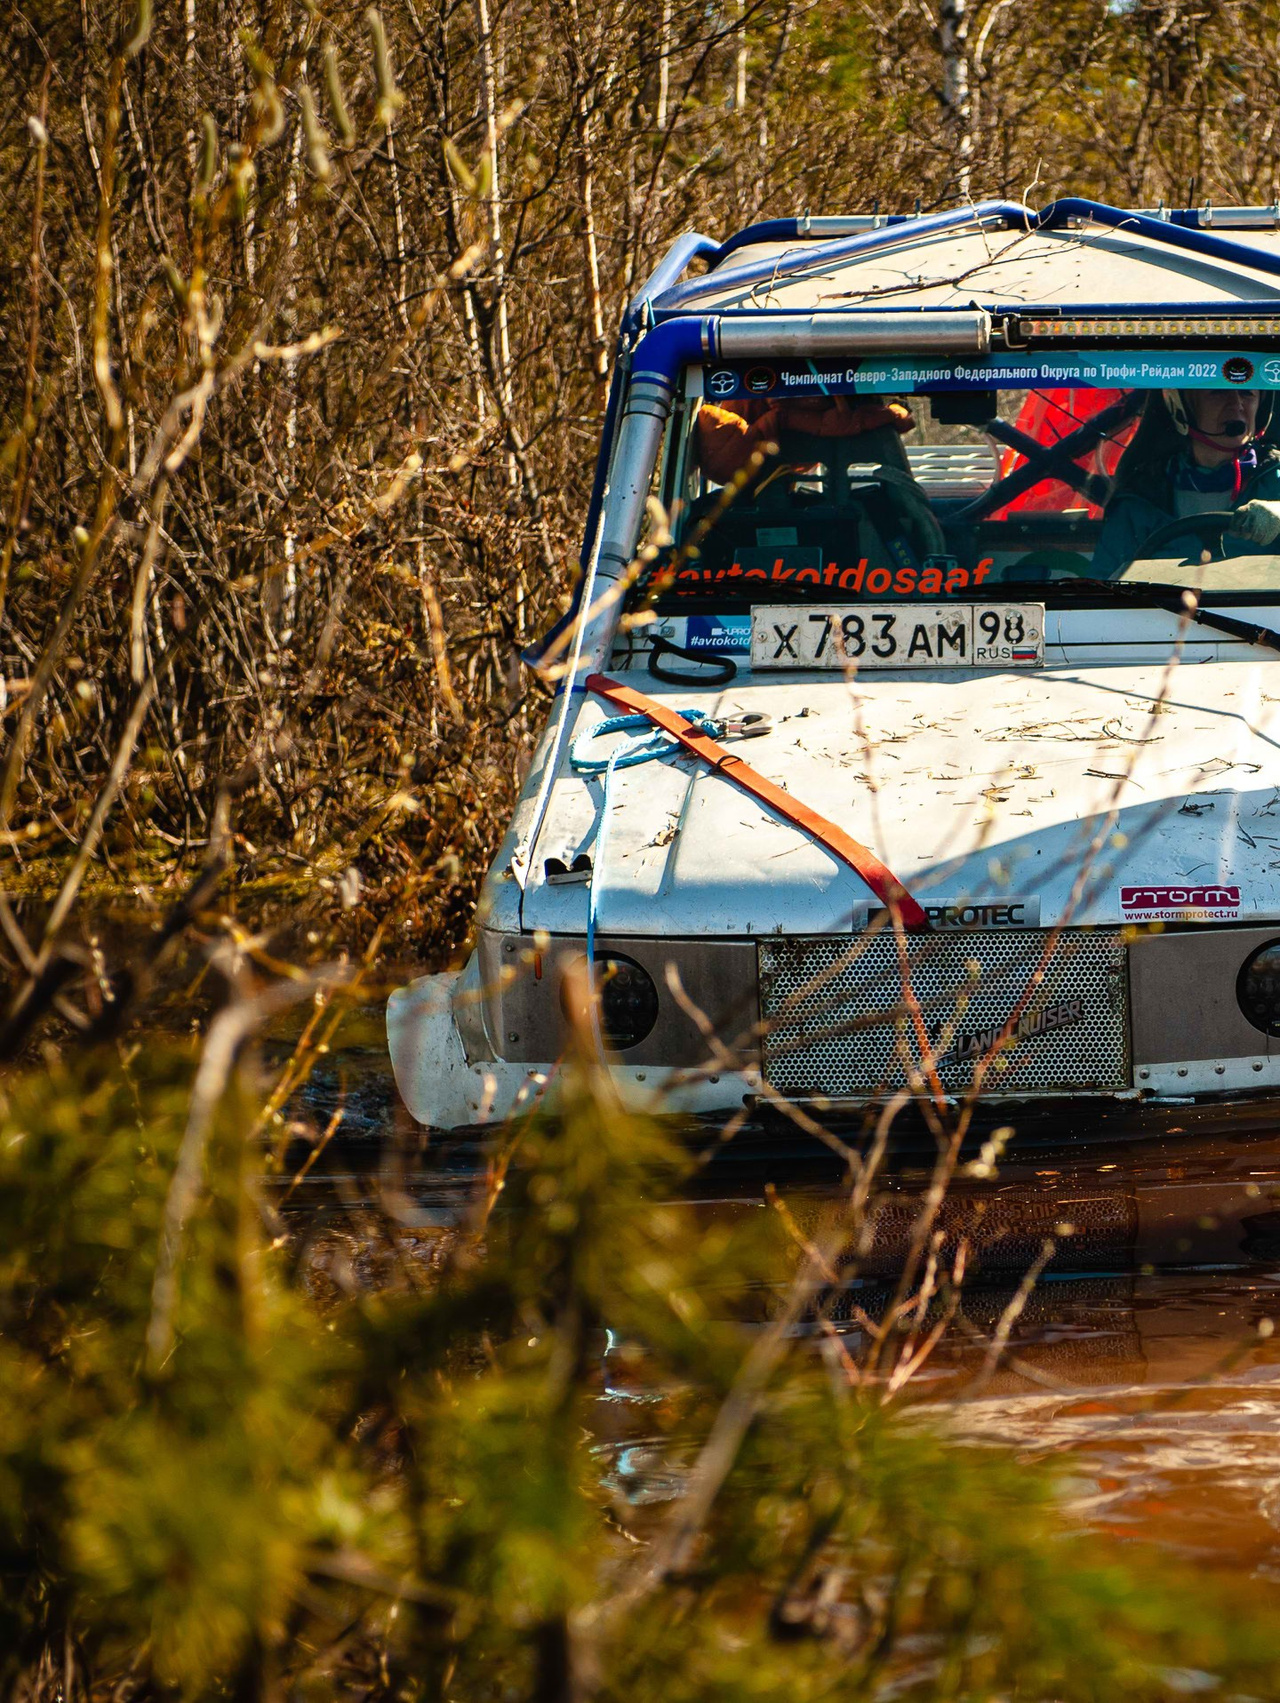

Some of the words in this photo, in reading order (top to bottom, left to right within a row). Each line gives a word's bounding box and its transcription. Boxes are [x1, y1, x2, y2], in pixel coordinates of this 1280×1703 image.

[780, 371, 842, 386] Чемпионат
[845, 366, 951, 384] Северо-Западного
[953, 365, 1038, 382] Федерального
[1040, 364, 1080, 380] Округа
[1083, 367, 1097, 378] по
[1099, 363, 1185, 380] Трофи-Рейдам
[1188, 363, 1218, 378] 2022
[979, 611, 1025, 645] 98
[976, 647, 1011, 660] RUS
[924, 903, 1025, 928] PROTEC
[1124, 909, 1238, 921] www.stormprotect.ru
